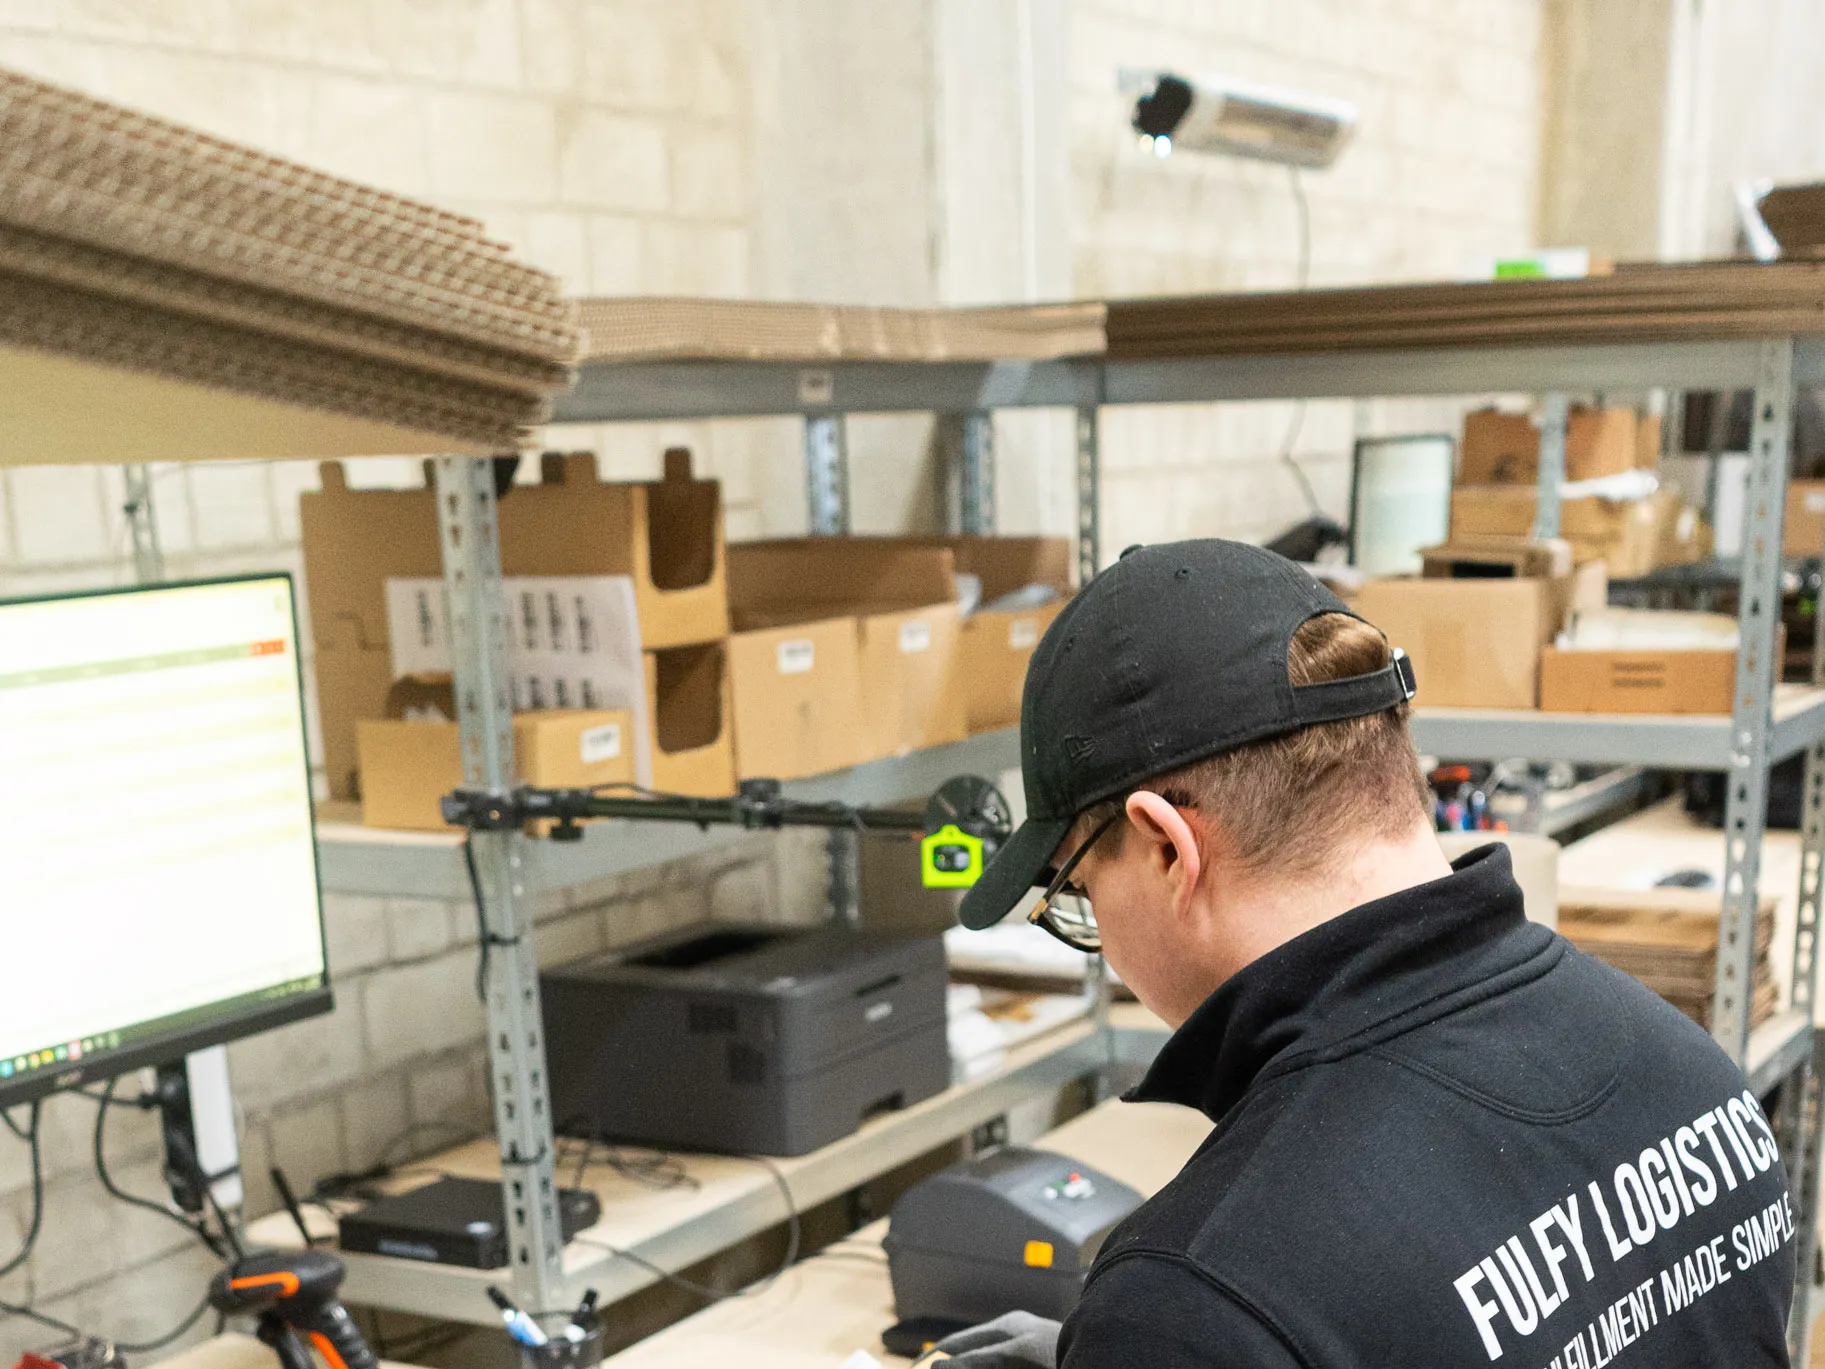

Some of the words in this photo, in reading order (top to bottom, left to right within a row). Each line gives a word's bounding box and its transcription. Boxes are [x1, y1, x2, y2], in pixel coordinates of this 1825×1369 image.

[1453, 1193, 1594, 1360] FULFY
[1588, 1090, 1780, 1261] LOGISTICS
[1660, 1235, 1731, 1315] MADE
[1732, 1190, 1795, 1271] SIMPLE
